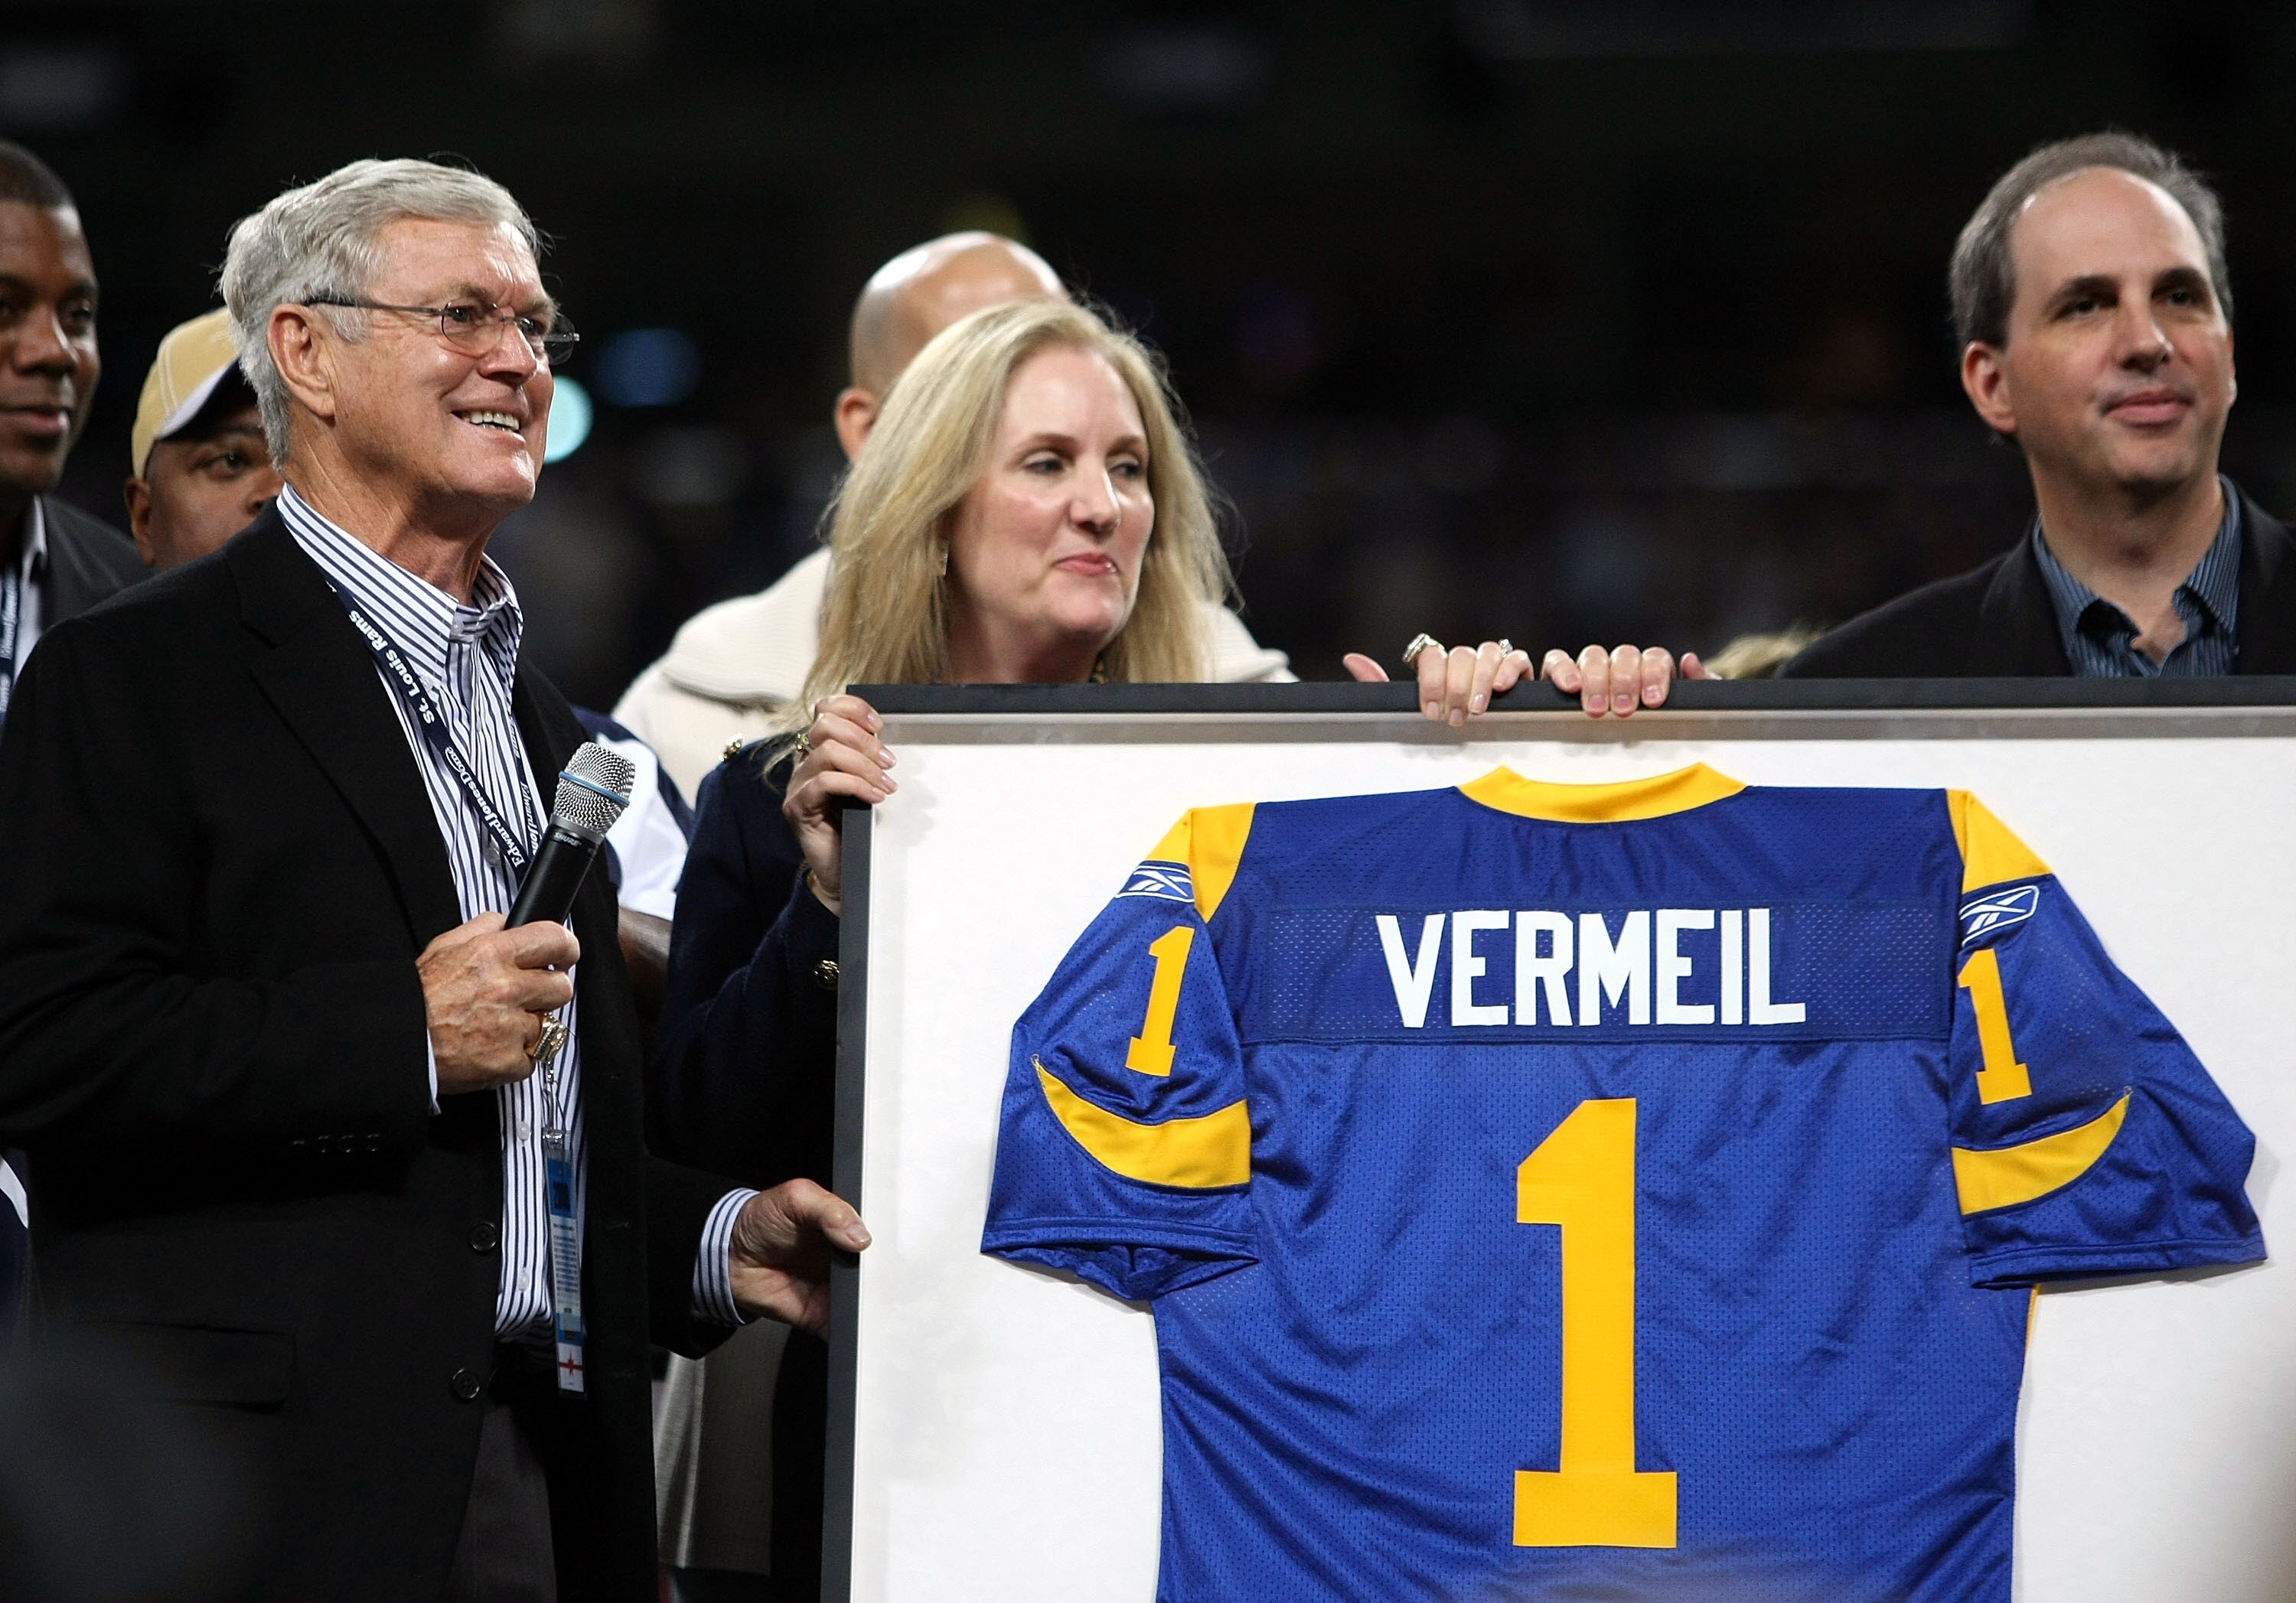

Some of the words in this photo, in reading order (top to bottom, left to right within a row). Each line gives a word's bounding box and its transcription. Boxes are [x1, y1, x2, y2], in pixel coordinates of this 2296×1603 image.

[349, 611, 388, 651] Rams
[386, 649, 420, 697] Louis
[419, 697, 435, 724] St.
[553, 832, 581, 847] SHURE
[1126, 927, 1195, 1076] 1
[1375, 908, 1805, 1028] VERMEIL
[1958, 950, 2031, 1103] 1
[1514, 1099, 1678, 1547] 1
